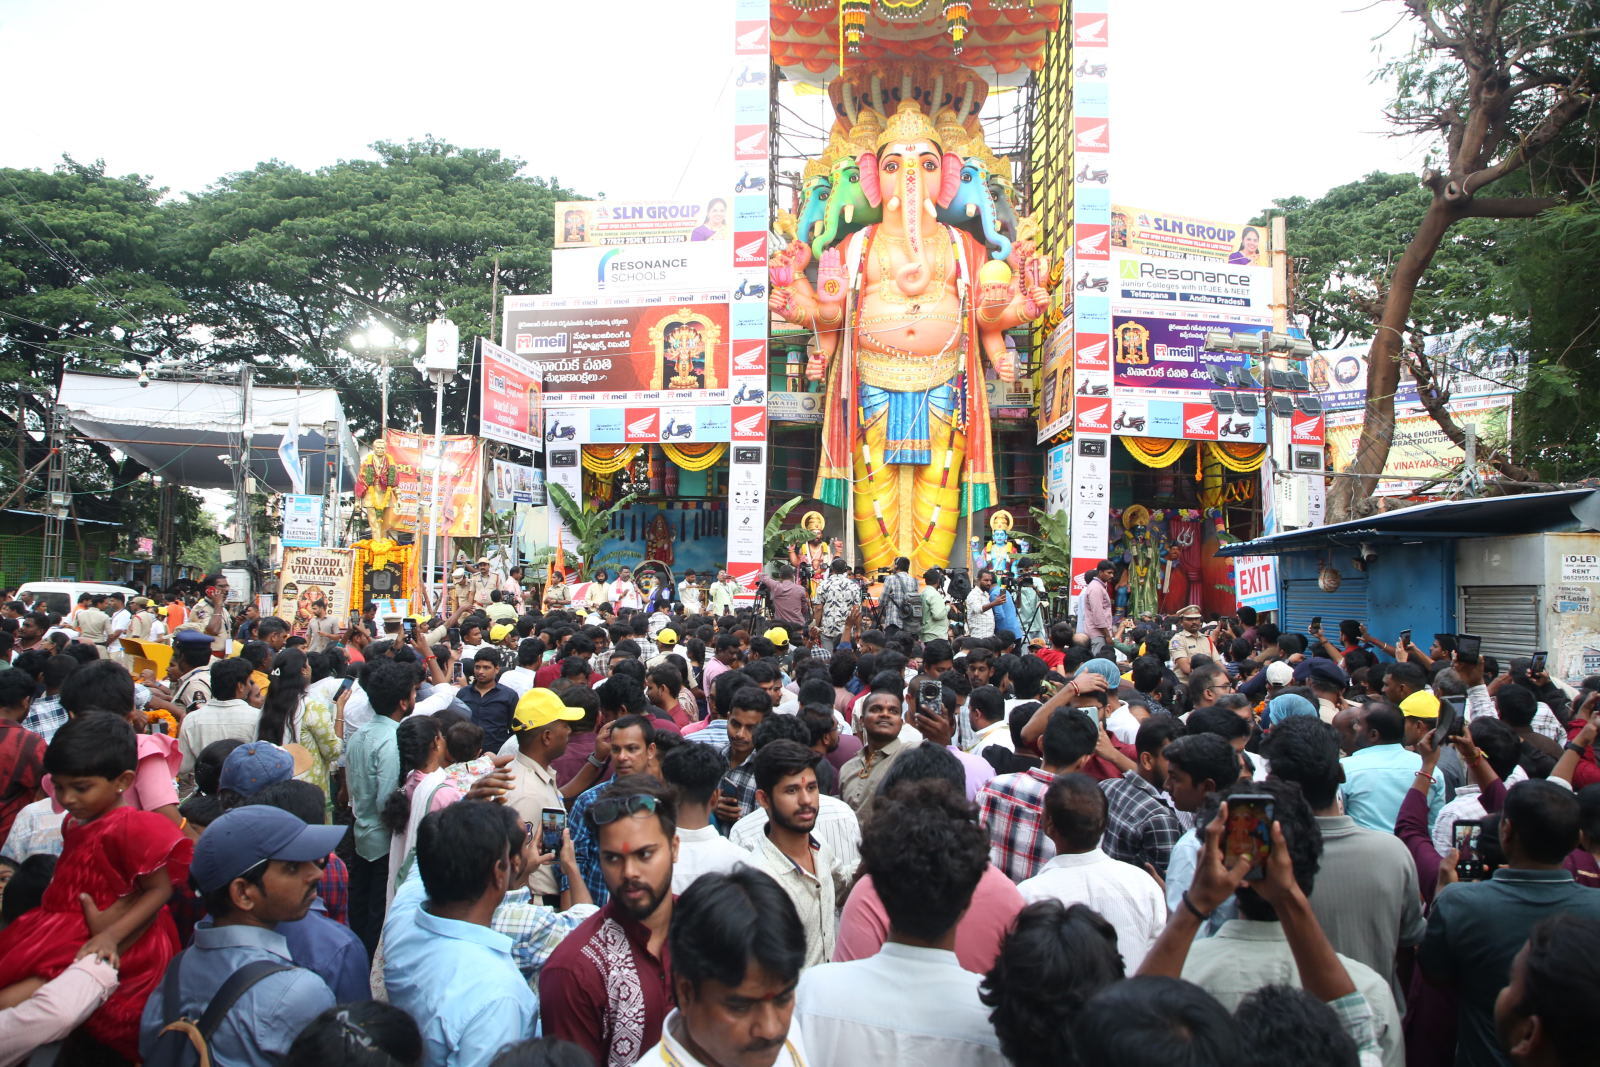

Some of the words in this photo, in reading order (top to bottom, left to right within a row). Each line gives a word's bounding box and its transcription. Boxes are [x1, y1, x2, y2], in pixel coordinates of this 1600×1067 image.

[613, 206, 644, 220] SLN
[647, 204, 700, 219] GROUP
[1154, 218, 1183, 234] SLN
[1186, 224, 1236, 242] GROUP
[612, 258, 688, 270] RESONANCE
[612, 271, 666, 282] SCHOOLS
[1140, 262, 1250, 286] Resonance
[1147, 281, 1179, 290] Colleges
[1130, 290, 1168, 299] Telangana
[1216, 297, 1245, 306] Pradesh
[535, 334, 566, 347] meil
[1170, 346, 1193, 357] meil
[583, 357, 612, 371] చవితి
[1127, 367, 1164, 378] వినాయక
[1167, 367, 1188, 379] చవితి
[1414, 430, 1445, 438] ENGINE
[1392, 436, 1450, 446] FRASTRUCTUR
[1394, 459, 1439, 470] VINAYAKA
[295, 556, 312, 565] SRI
[313, 557, 340, 567] SIDDI
[291, 565, 344, 577] VINAYAKA
[1240, 563, 1270, 595] EXIT
